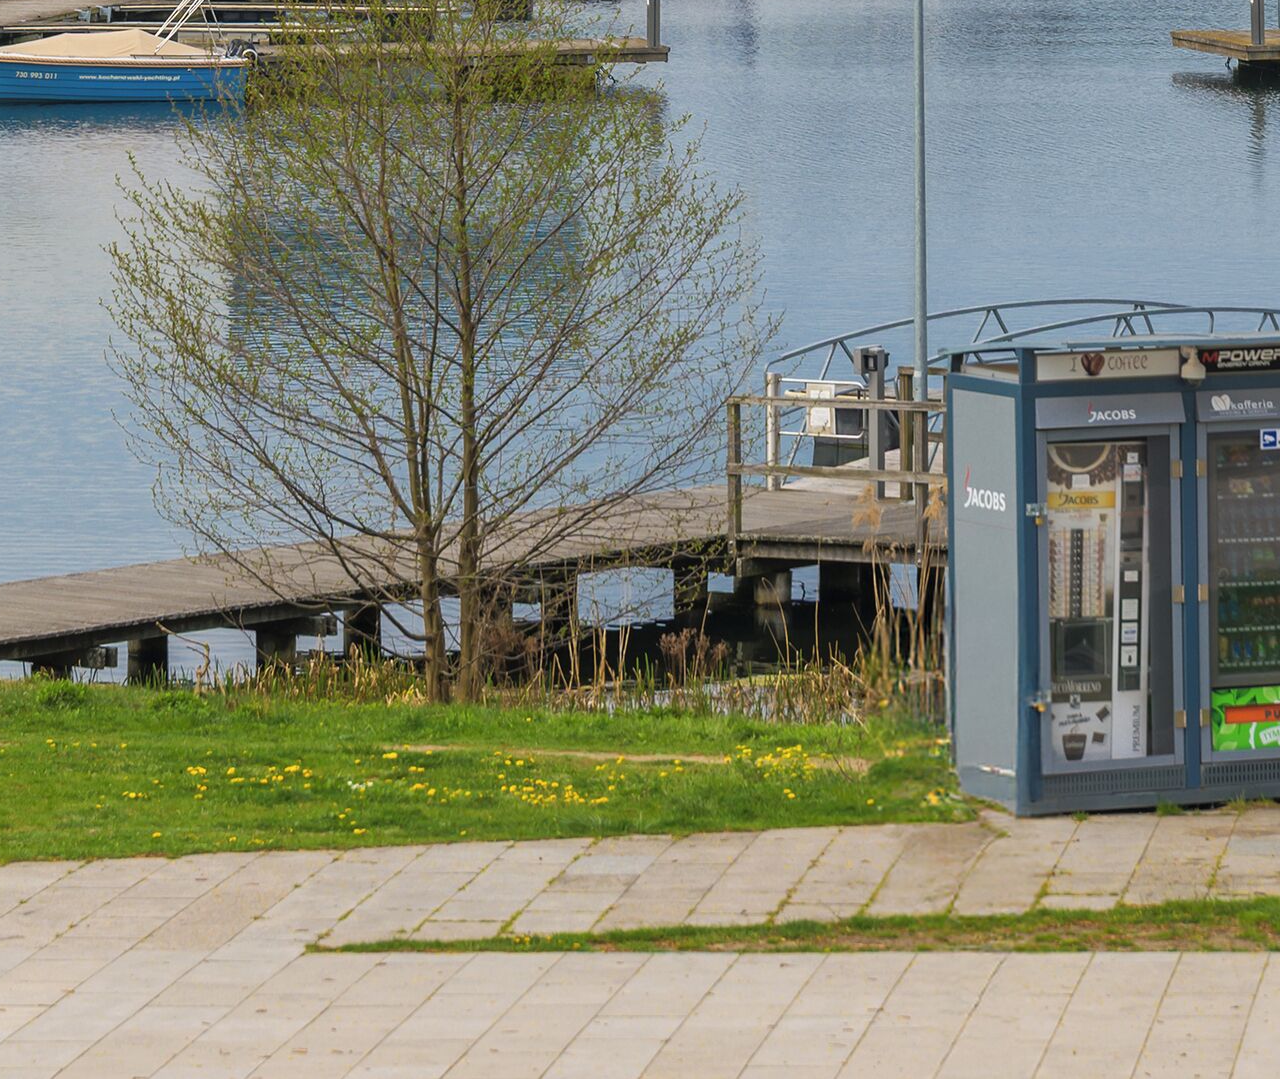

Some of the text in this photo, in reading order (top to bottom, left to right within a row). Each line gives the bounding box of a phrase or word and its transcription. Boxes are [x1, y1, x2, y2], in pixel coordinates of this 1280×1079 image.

[1070, 357, 1076, 372] I
[1087, 408, 1136, 423] JACOBS
[963, 486, 1007, 512] JACOBS
